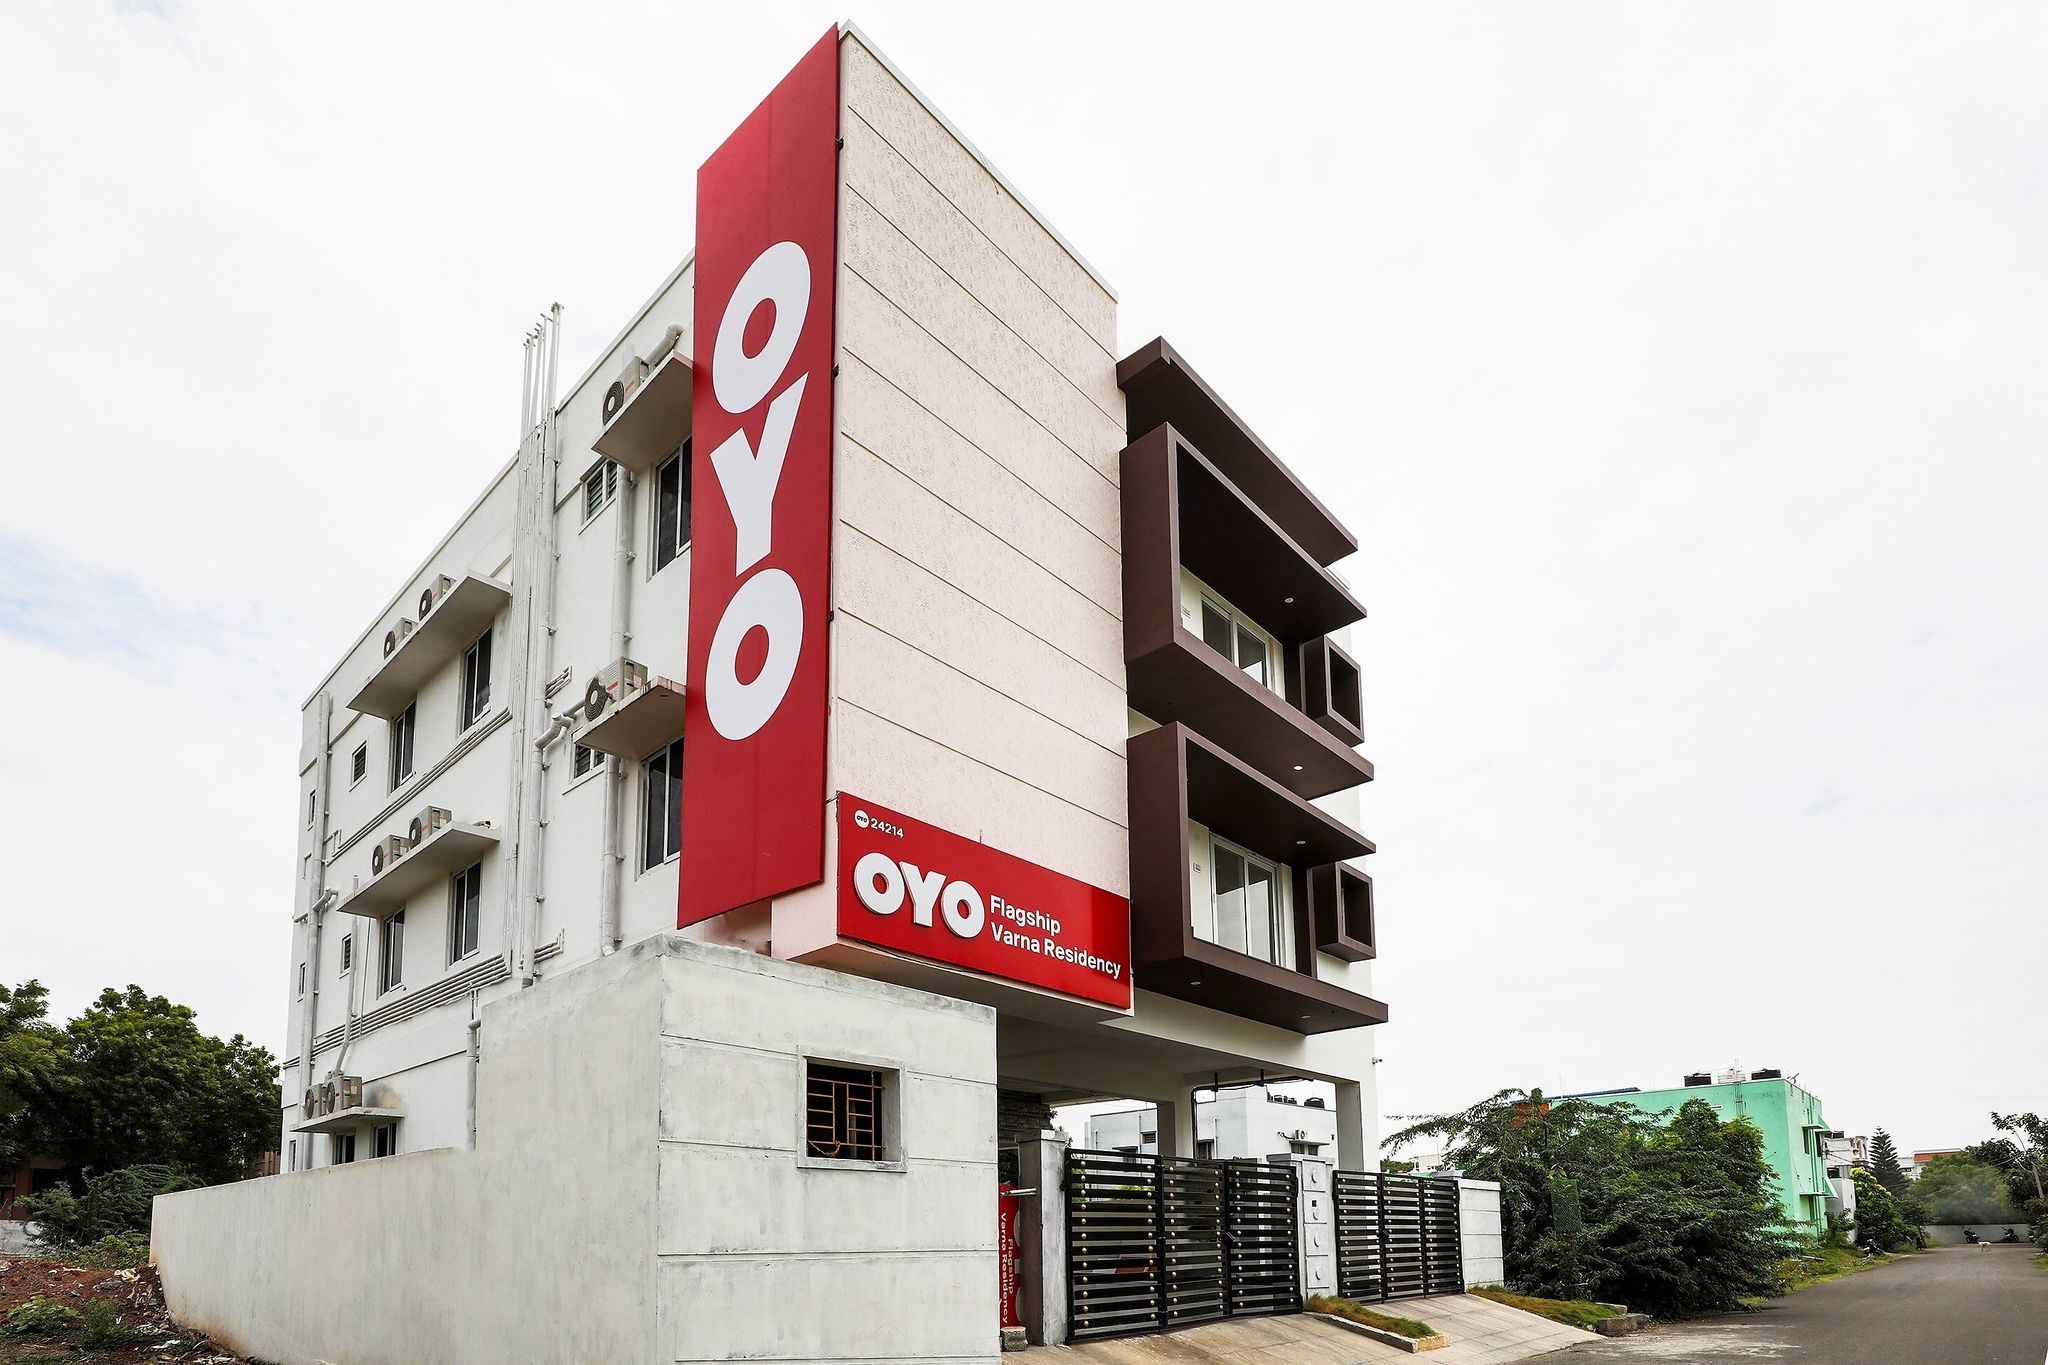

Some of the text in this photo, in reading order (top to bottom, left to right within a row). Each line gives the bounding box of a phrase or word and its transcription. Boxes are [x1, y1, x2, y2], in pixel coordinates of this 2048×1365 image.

[705, 240, 812, 741] OYO
[870, 817, 904, 838] 24214
[853, 852, 985, 939] OYO
[990, 895, 1061, 936] Flagship
[991, 921, 1121, 980] Varna Residency
[1000, 1212, 1009, 1324] Varna Residency
[1007, 1238, 1015, 1295] Flagship
